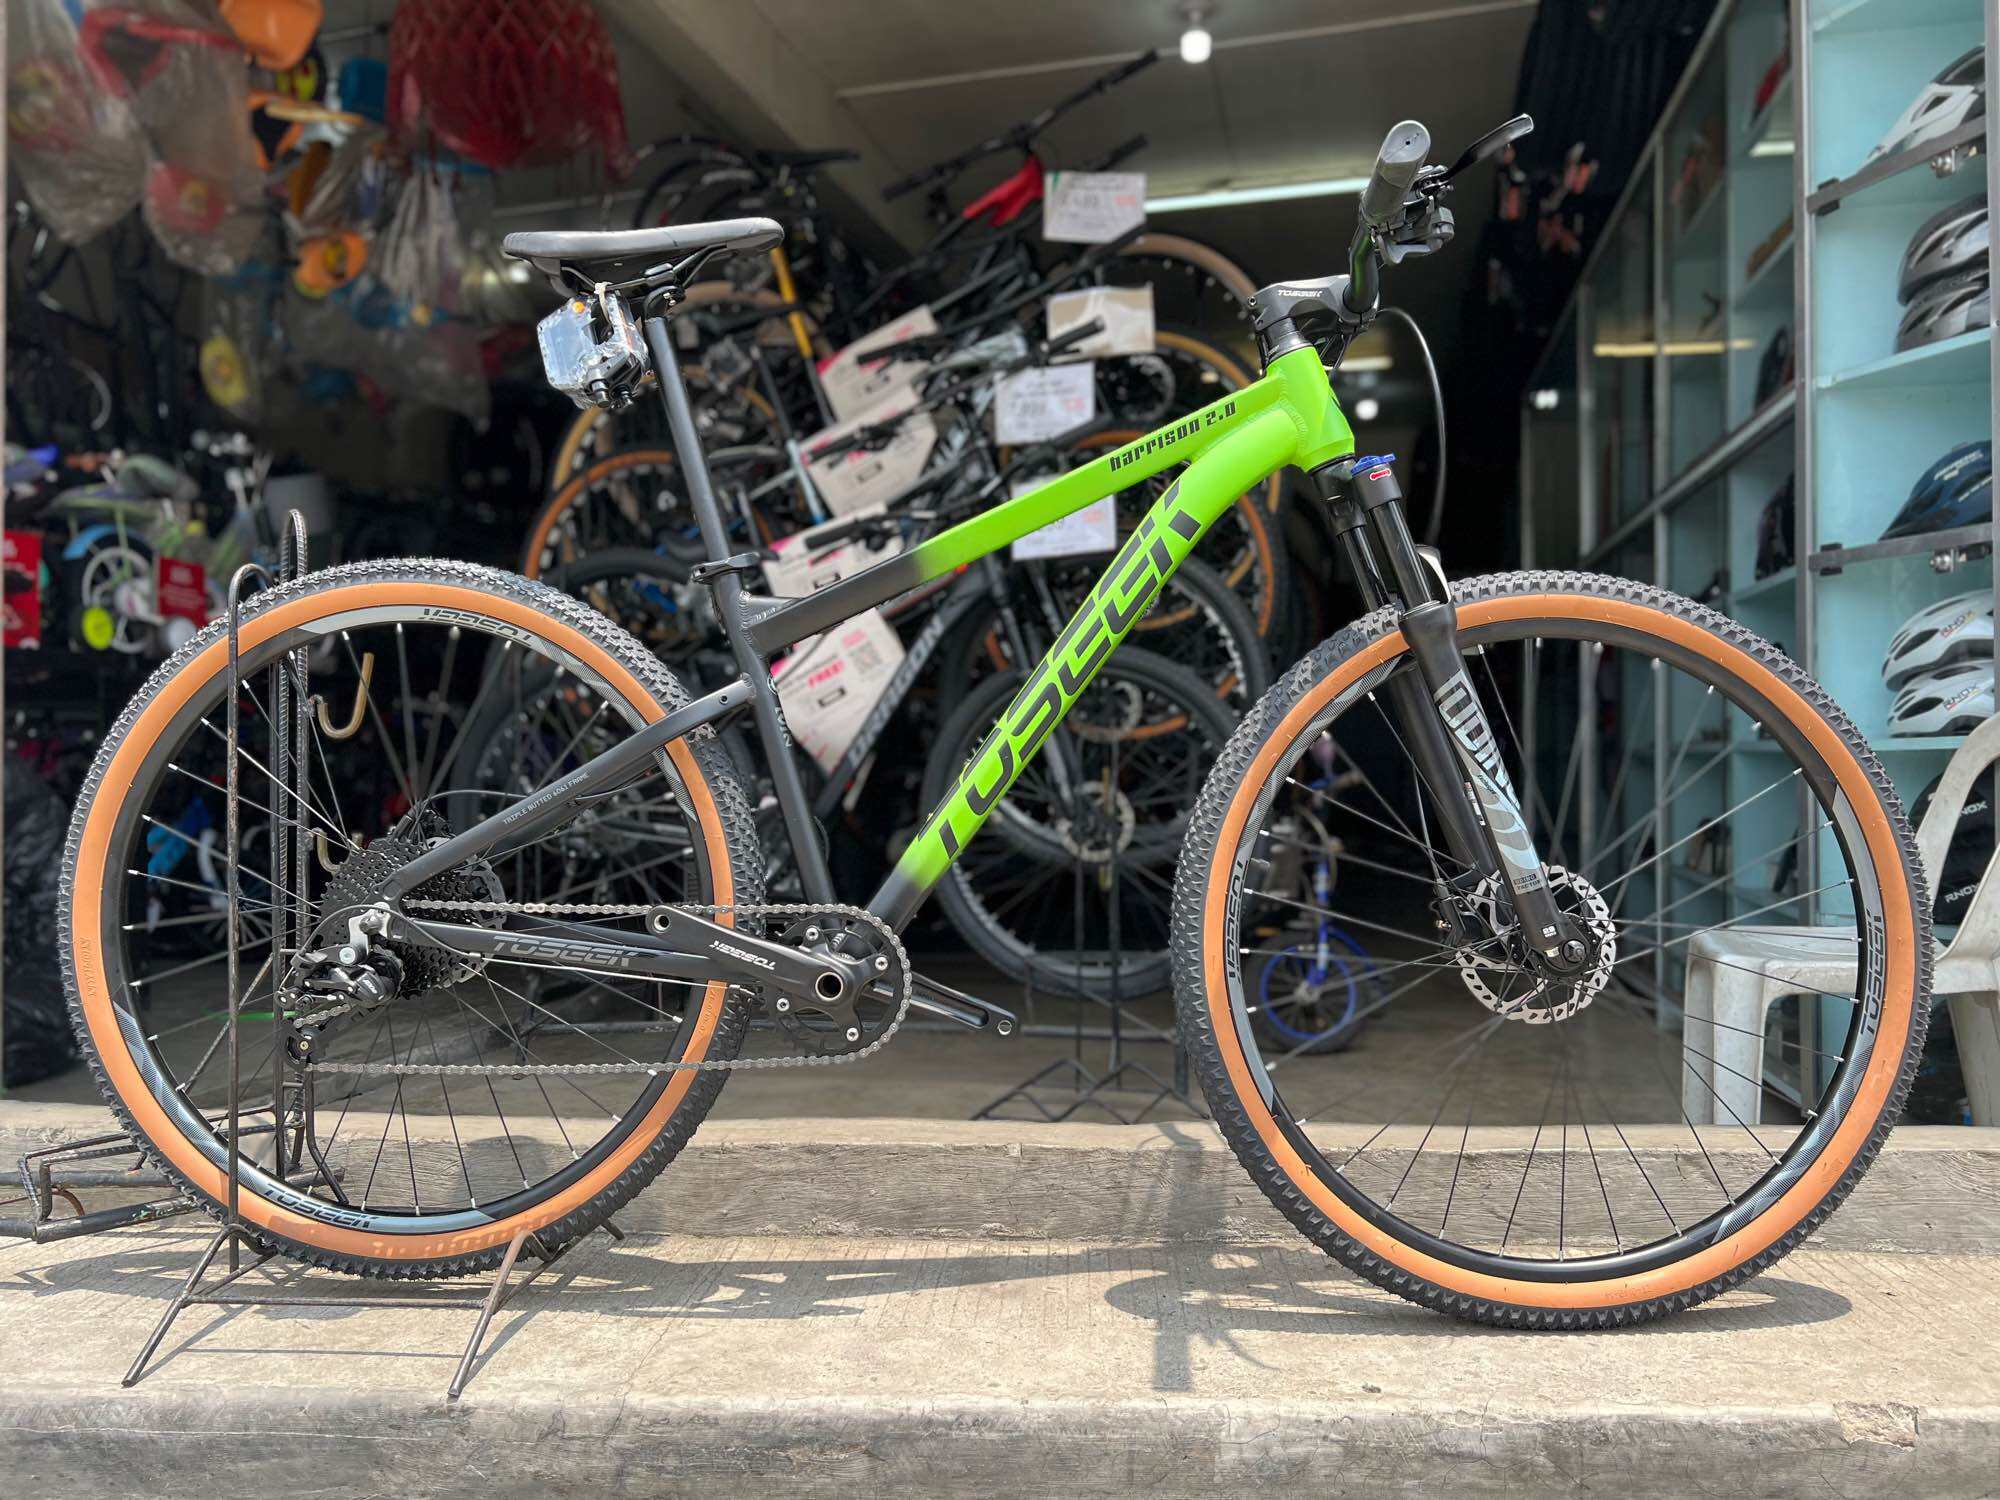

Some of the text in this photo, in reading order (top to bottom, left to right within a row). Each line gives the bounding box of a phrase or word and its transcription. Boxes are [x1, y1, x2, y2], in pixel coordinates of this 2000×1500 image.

[1205, 401, 1236, 427] 2.0
[917, 478, 1200, 859] TOSEEK
[503, 808, 528, 825] TRIPLE
[527, 793, 553, 811] BUTTED
[568, 772, 590, 787] FRAME
[1960, 801, 1988, 817] NOX
[492, 935, 639, 968] TOSEEK
[264, 1184, 379, 1229] TOSEEK
